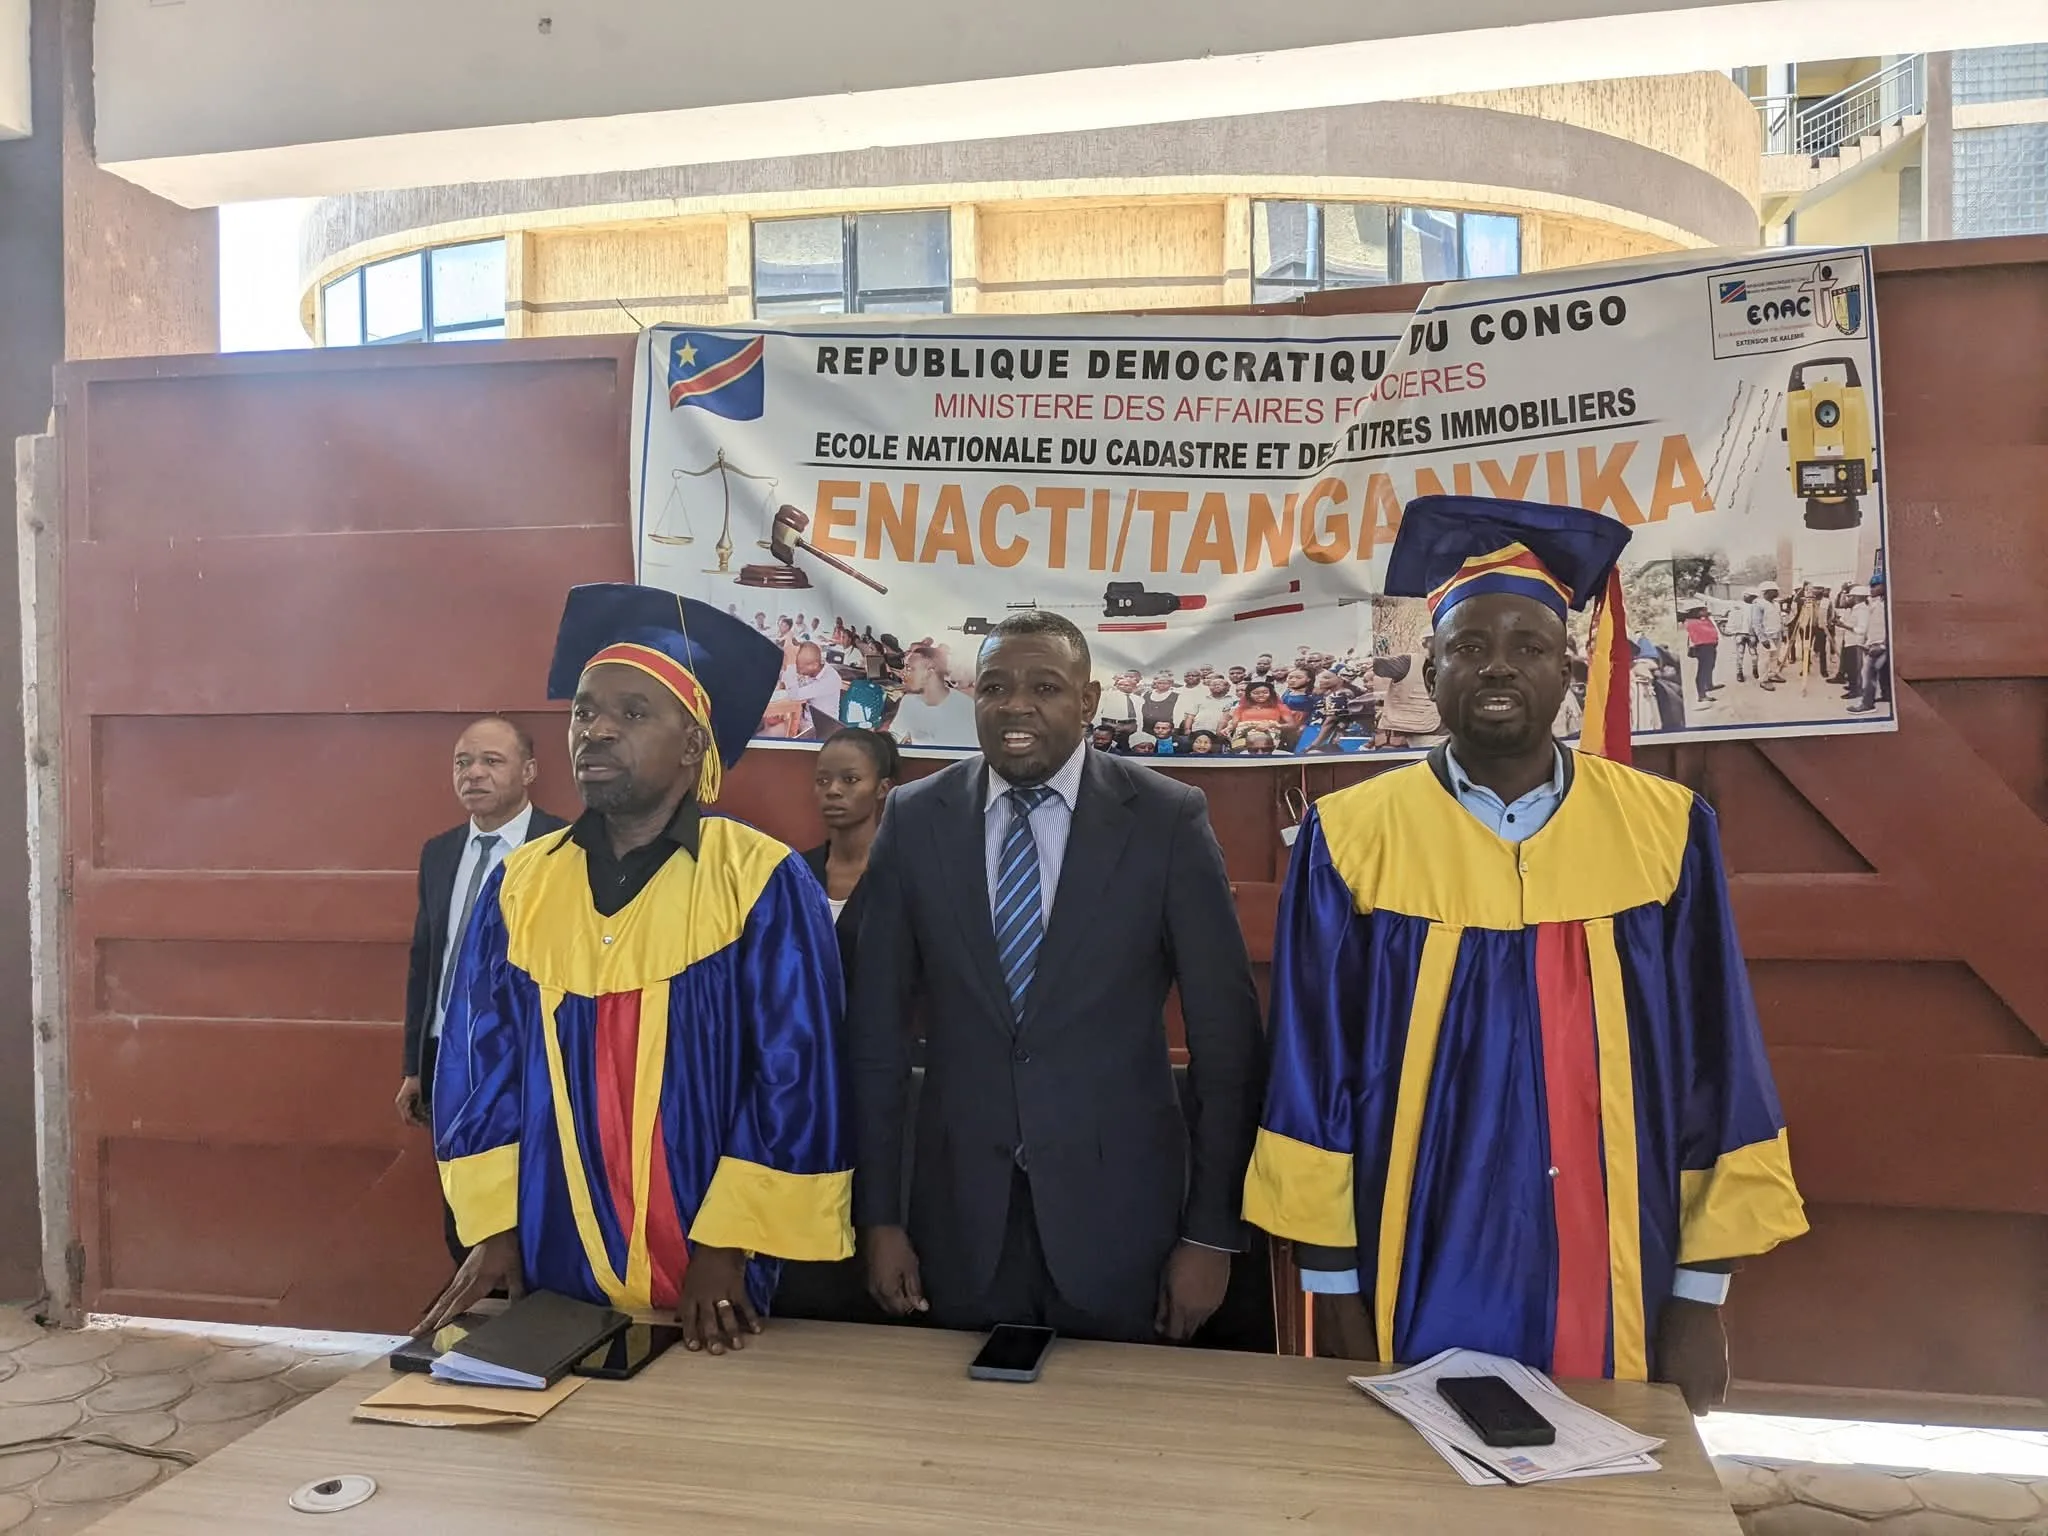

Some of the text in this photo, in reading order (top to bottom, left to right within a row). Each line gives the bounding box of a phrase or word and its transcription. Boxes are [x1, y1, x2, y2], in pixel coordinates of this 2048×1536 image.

[1747, 296, 1811, 325] ENAC
[816, 295, 1627, 384] REPUBLIQUE DEMOCRATIQU DU CONGO
[814, 431, 899, 461] ECOLE
[905, 435, 1052, 464] NATIONALE
[1060, 438, 1098, 466] DU
[1106, 439, 1247, 470] CADASTRE
[1255, 442, 1290, 470] ET
[1346, 415, 1432, 451] TITRES
[1441, 387, 1636, 440] IMMOBILIERS
[935, 394, 1094, 419] MINISTERE
[1103, 395, 1166, 422] DES
[1174, 396, 1324, 425] AFFAIRES
